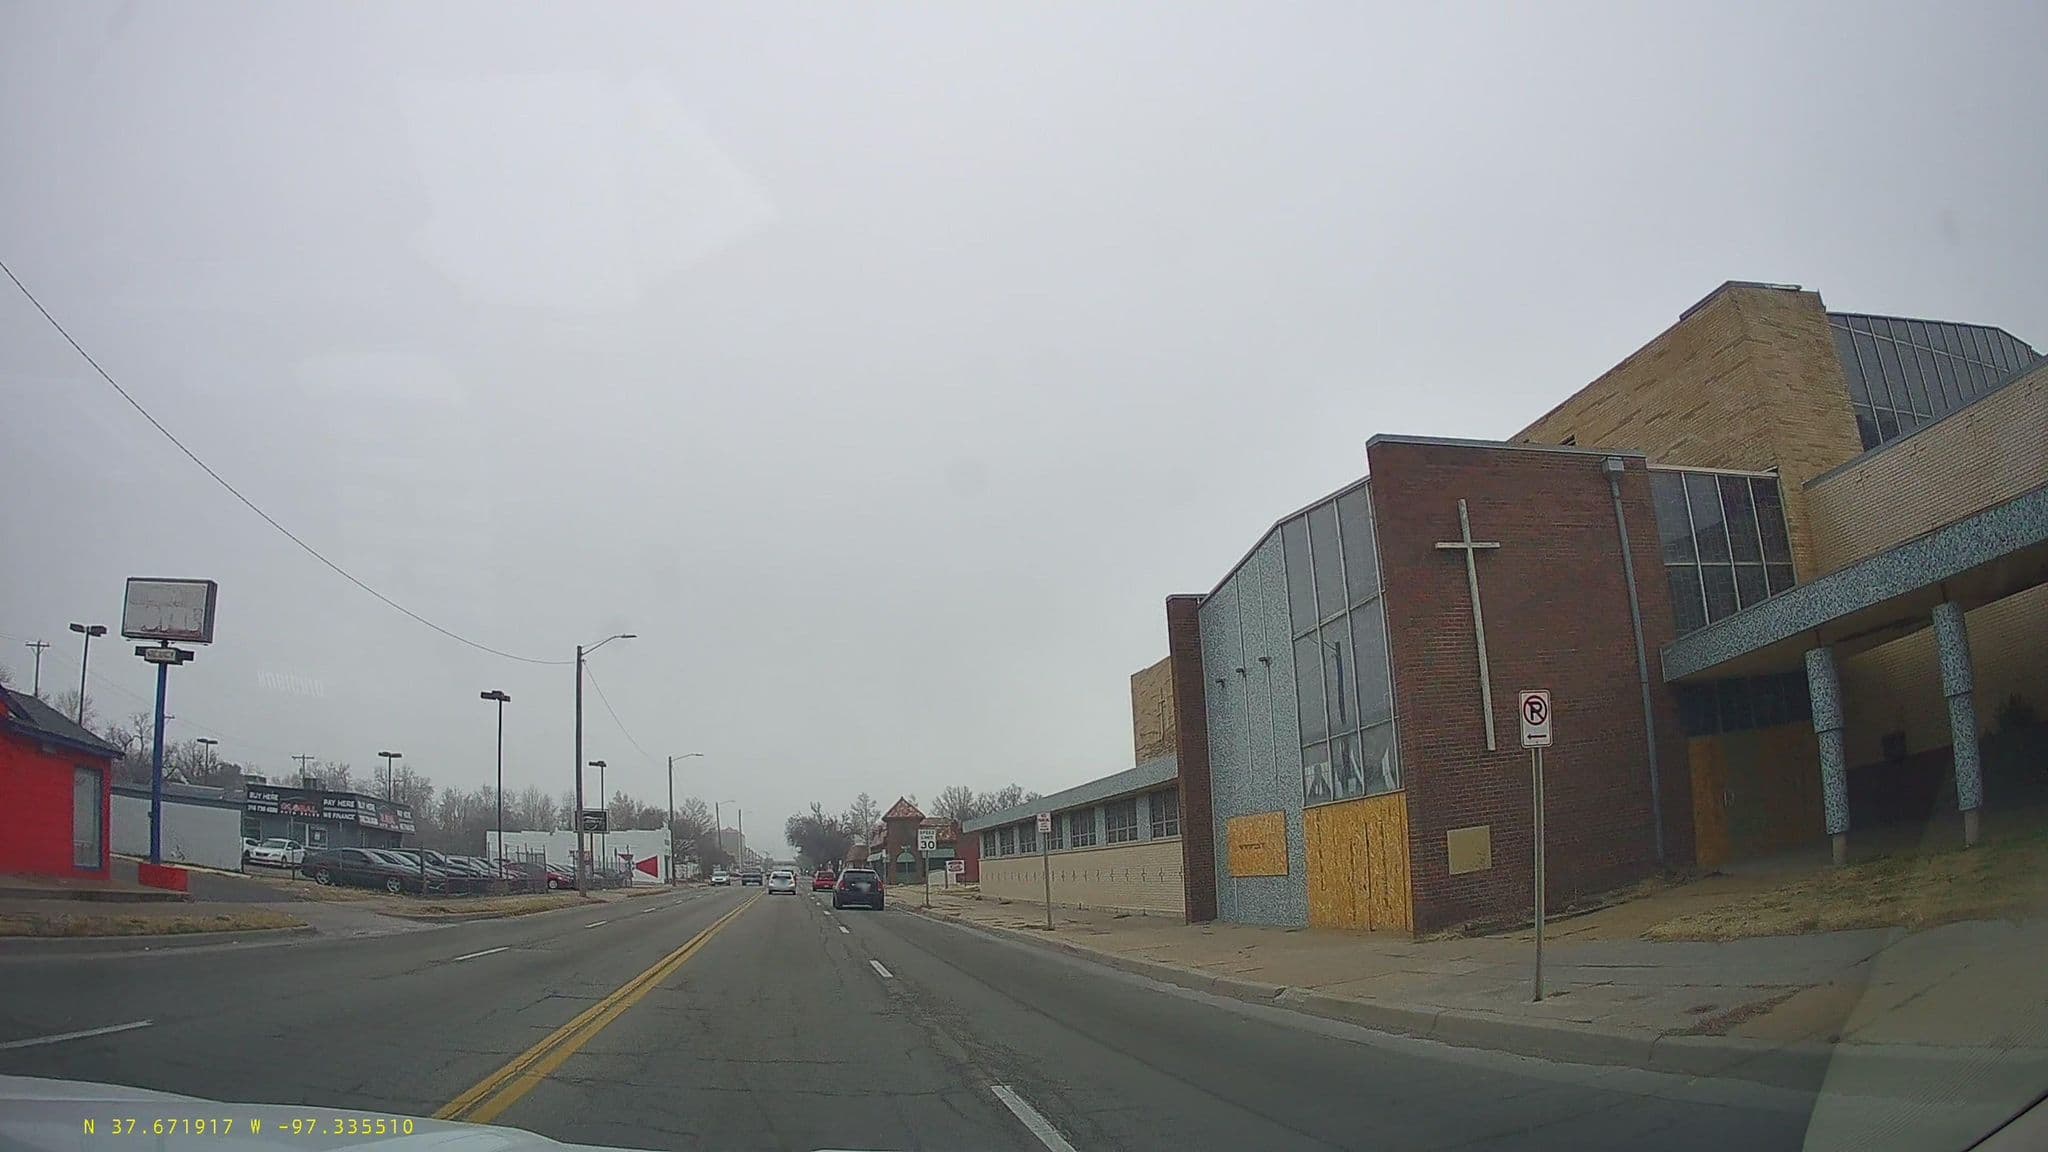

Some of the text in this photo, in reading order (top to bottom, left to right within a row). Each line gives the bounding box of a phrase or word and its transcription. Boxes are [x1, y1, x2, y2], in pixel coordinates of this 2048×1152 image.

[323, 798, 355, 808] PAY HERE
[920, 840, 935, 849] 30
